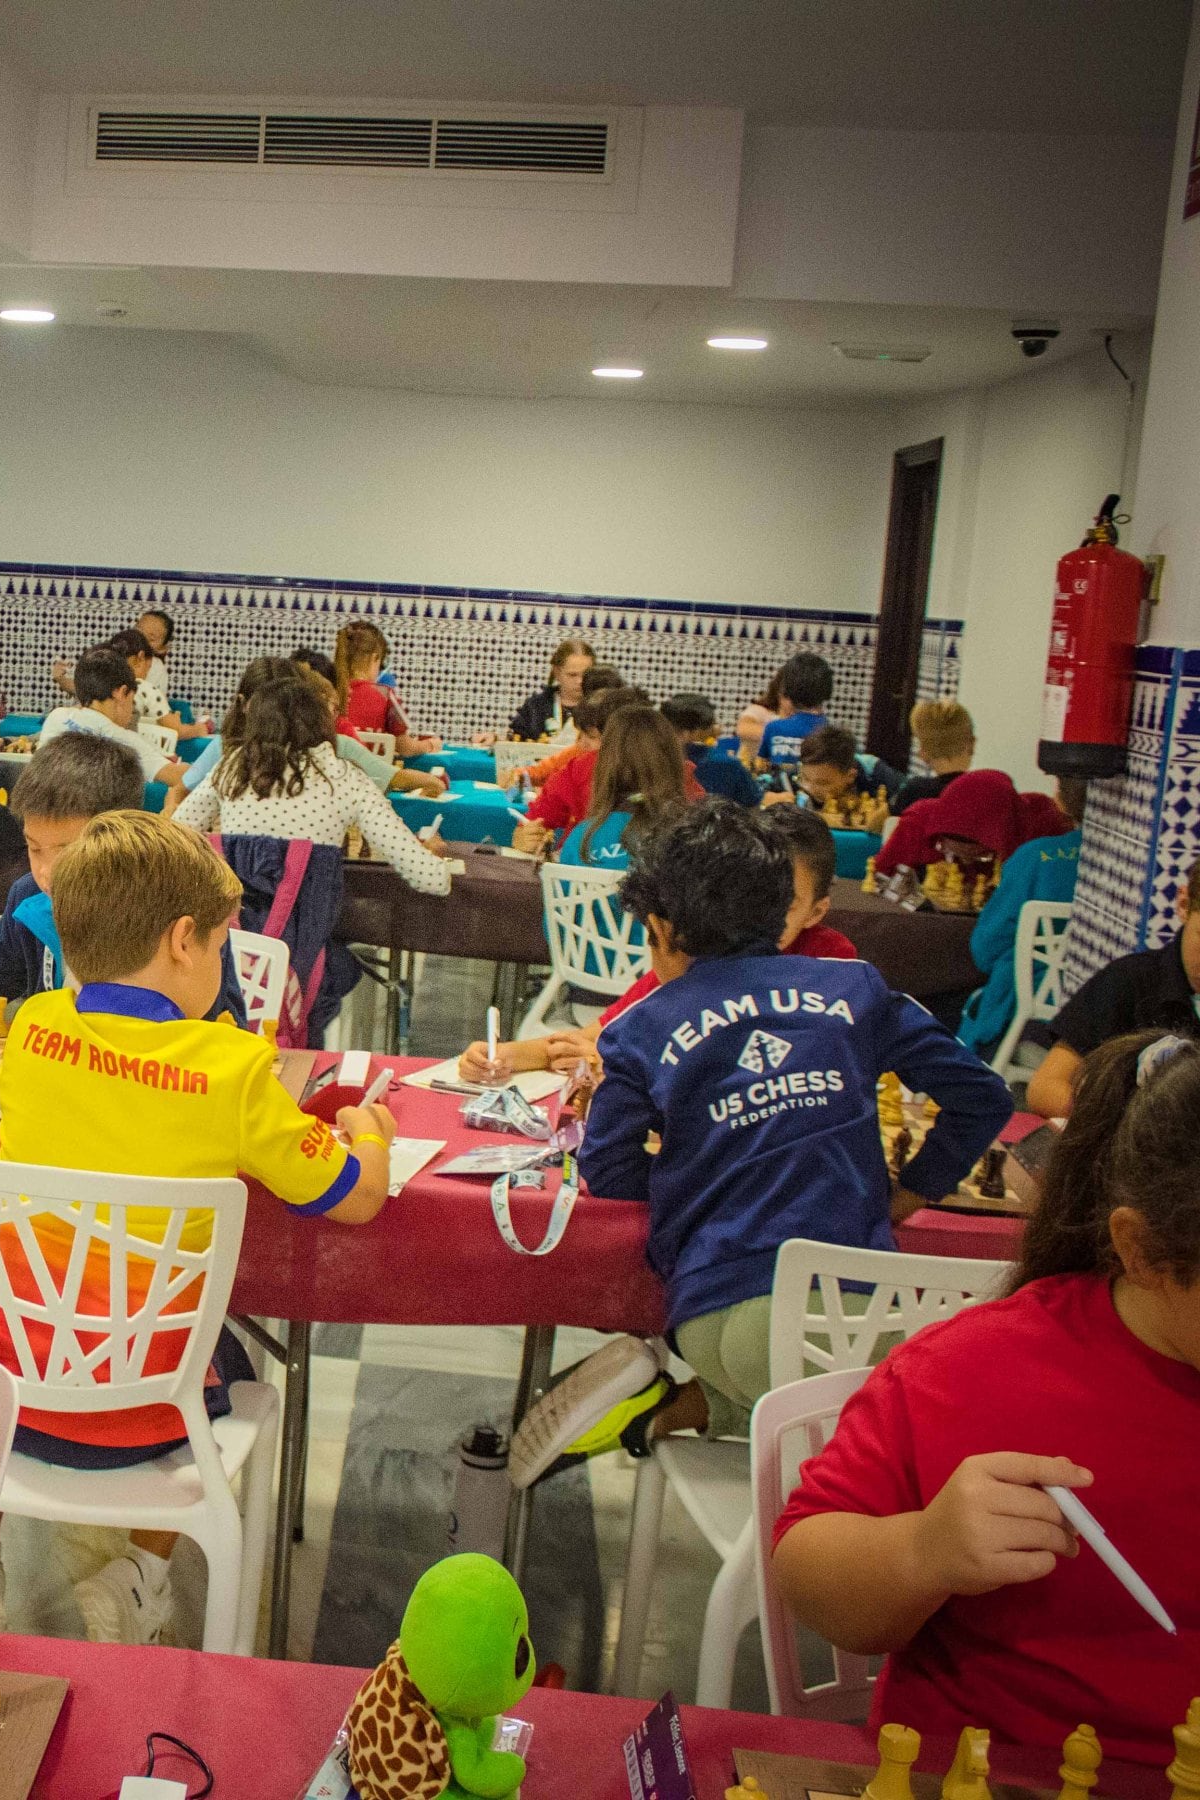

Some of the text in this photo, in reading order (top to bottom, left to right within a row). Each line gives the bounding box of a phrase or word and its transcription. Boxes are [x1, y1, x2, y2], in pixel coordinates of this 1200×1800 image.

[660, 988, 854, 1066] TEAM USA
[23, 1023, 208, 1095] TEAM ROMANIA
[708, 1070, 844, 1122] US CHESS
[730, 1096, 828, 1130] FEDERATION
